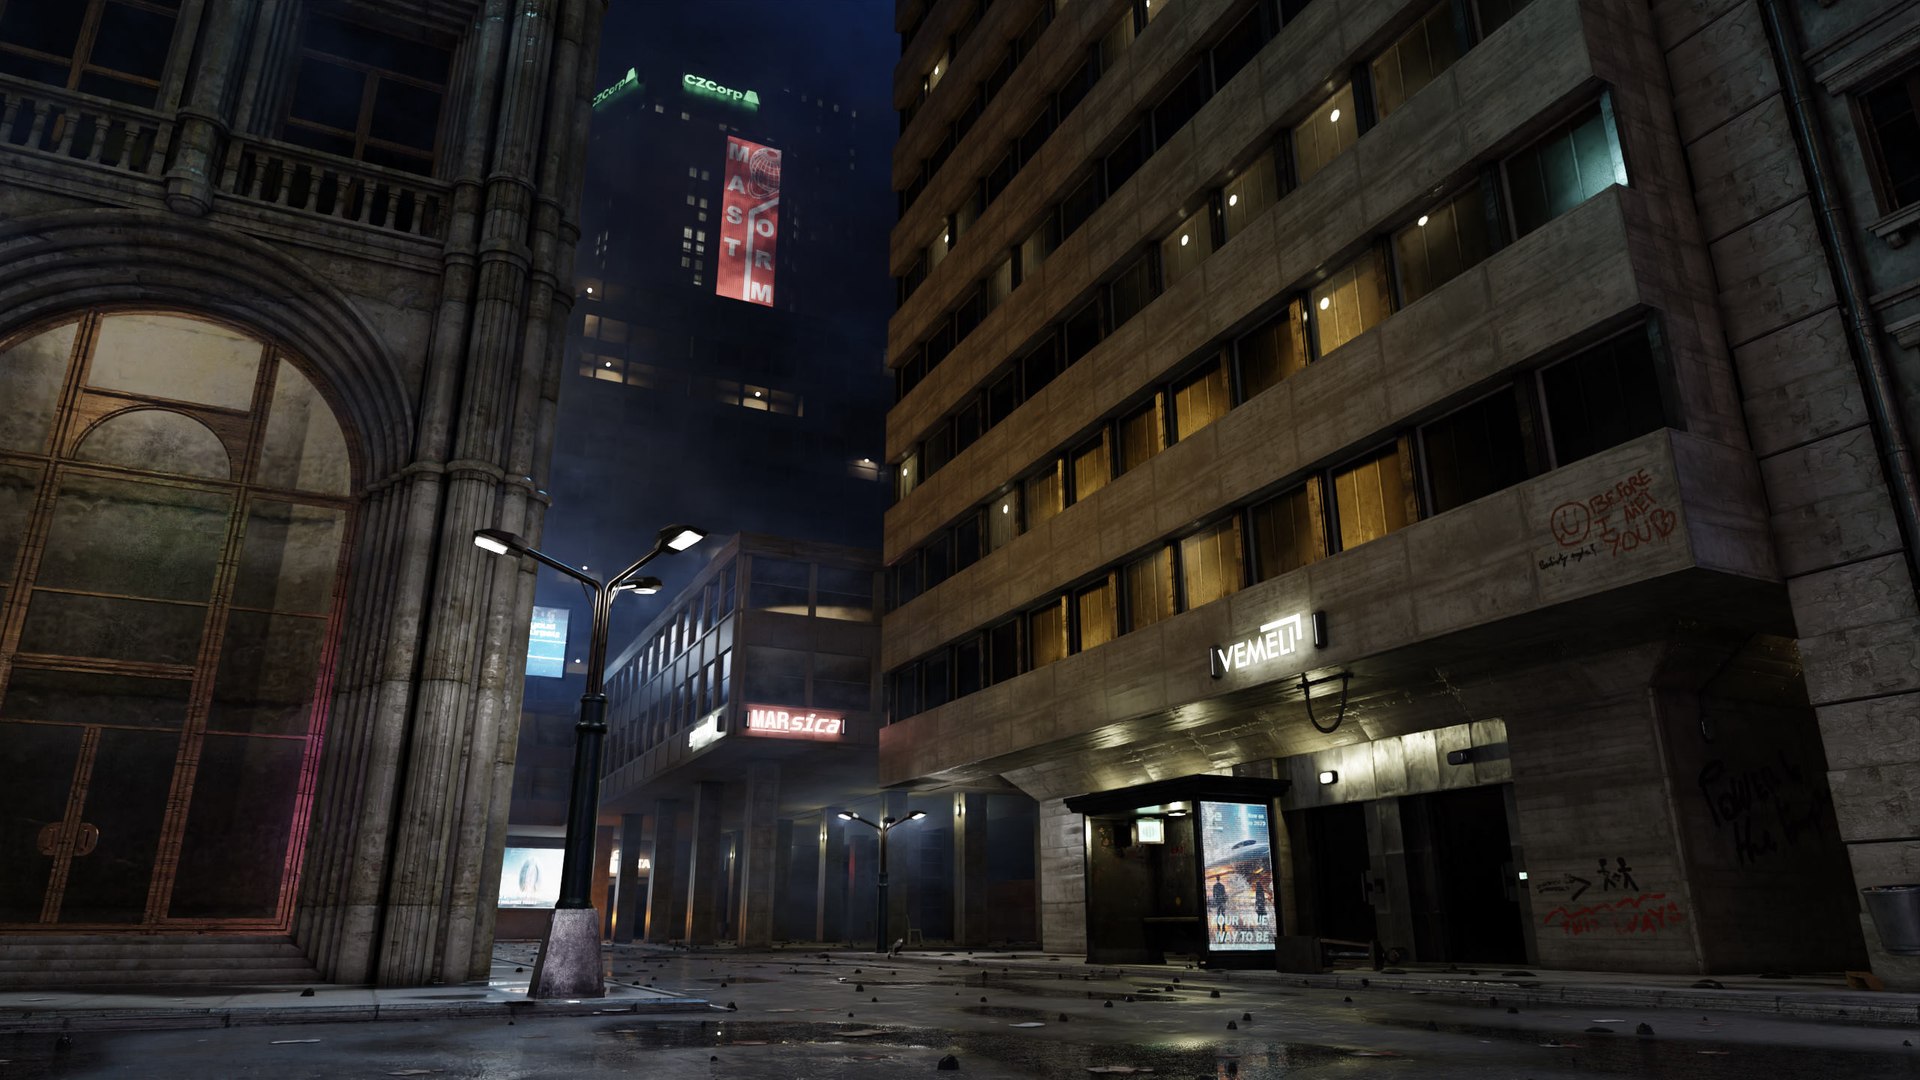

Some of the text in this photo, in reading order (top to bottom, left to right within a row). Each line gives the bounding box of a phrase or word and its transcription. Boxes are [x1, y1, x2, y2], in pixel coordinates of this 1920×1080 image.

[684, 74, 743, 101] CZCorp
[1623, 487, 1656, 525] MET
[1603, 519, 1651, 557] YOU
[751, 709, 841, 734] MARsica
[1211, 914, 1269, 926] YOUR TRUE
[1215, 931, 1270, 943] WAY TO BE
